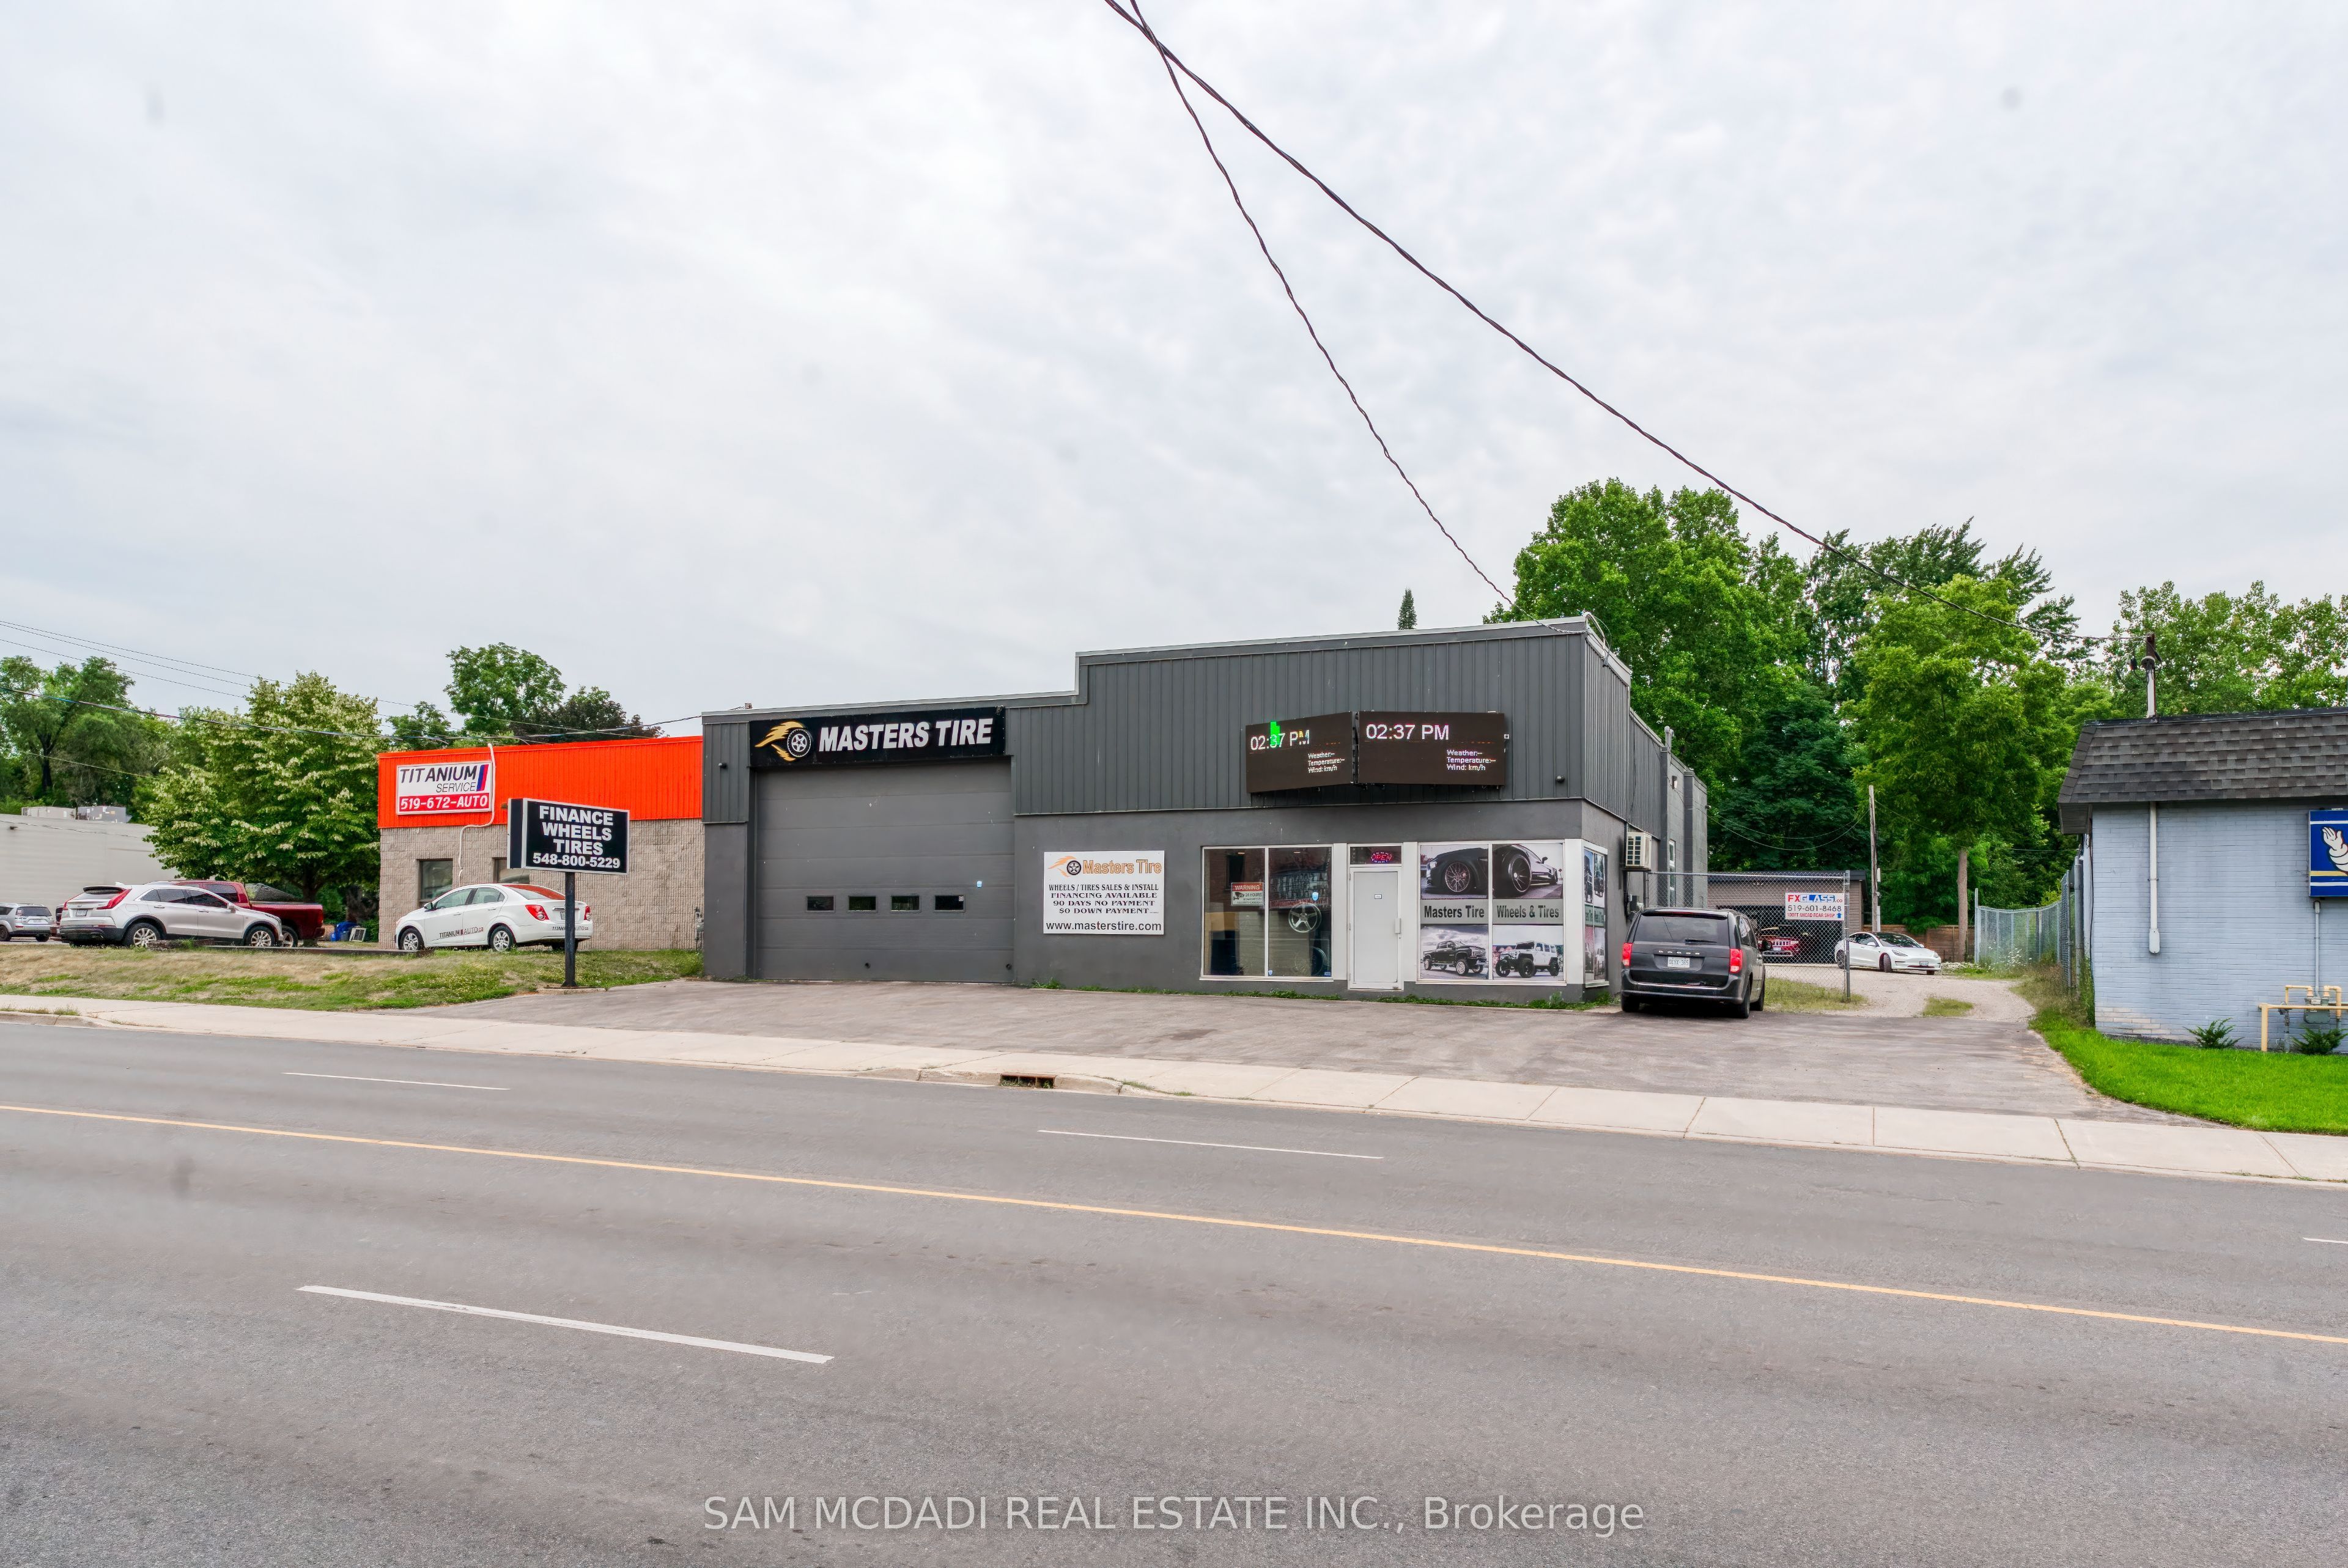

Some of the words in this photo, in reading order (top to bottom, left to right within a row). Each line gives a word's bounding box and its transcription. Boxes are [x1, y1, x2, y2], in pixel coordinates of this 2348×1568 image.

[819, 721, 929, 752] MASTERS
[936, 718, 993, 746] TIRE
[1250, 732, 1285, 751] 02:37
[1290, 729, 1310, 746] PM
[1366, 724, 1416, 740] 02:37
[1422, 724, 1449, 740] PM
[400, 765, 478, 783] TITANIUM
[436, 782, 476, 793] SERVICE
[401, 795, 488, 810] 519-672-AUTO
[539, 805, 613, 826] FINANCE
[542, 822, 612, 841] WHEELS
[553, 839, 604, 856] TIRES
[533, 853, 621, 869] 548-800-5229
[1082, 859, 1134, 874] Masters
[1136, 859, 1162, 874] Tire
[1424, 905, 1463, 918] Masters
[1465, 905, 1485, 918] Tire
[1497, 905, 1527, 918] Wheels
[1529, 905, 1535, 918] &
[1538, 905, 1559, 918] Tires
[1046, 921, 1162, 931] www.masterstire.com
